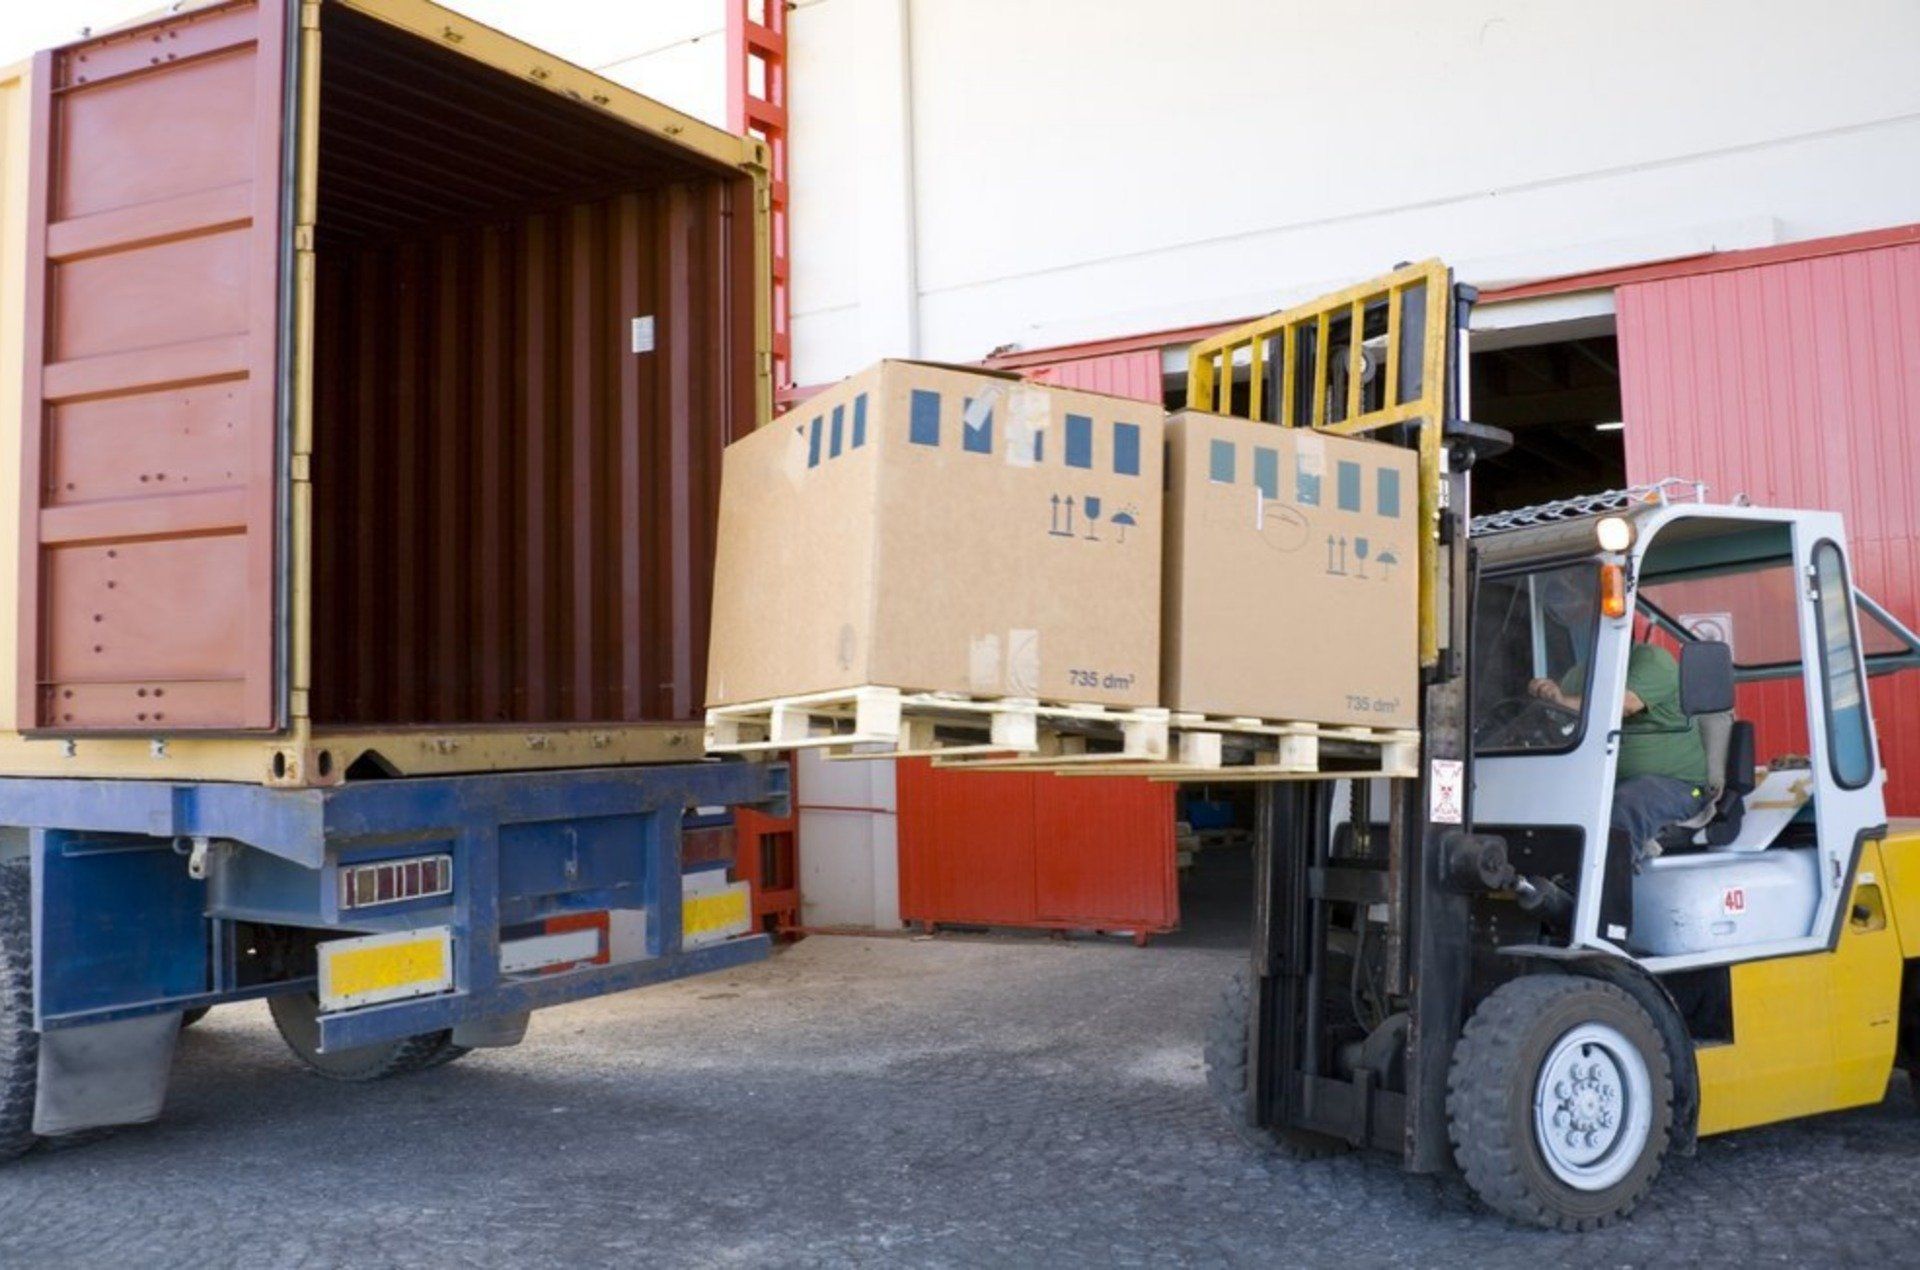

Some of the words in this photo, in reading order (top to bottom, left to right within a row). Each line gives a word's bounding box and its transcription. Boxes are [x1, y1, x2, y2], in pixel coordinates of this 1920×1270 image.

[1069, 669, 1097, 687] 735
[1345, 694, 1369, 711] 735
[1725, 890, 1744, 910] 40
